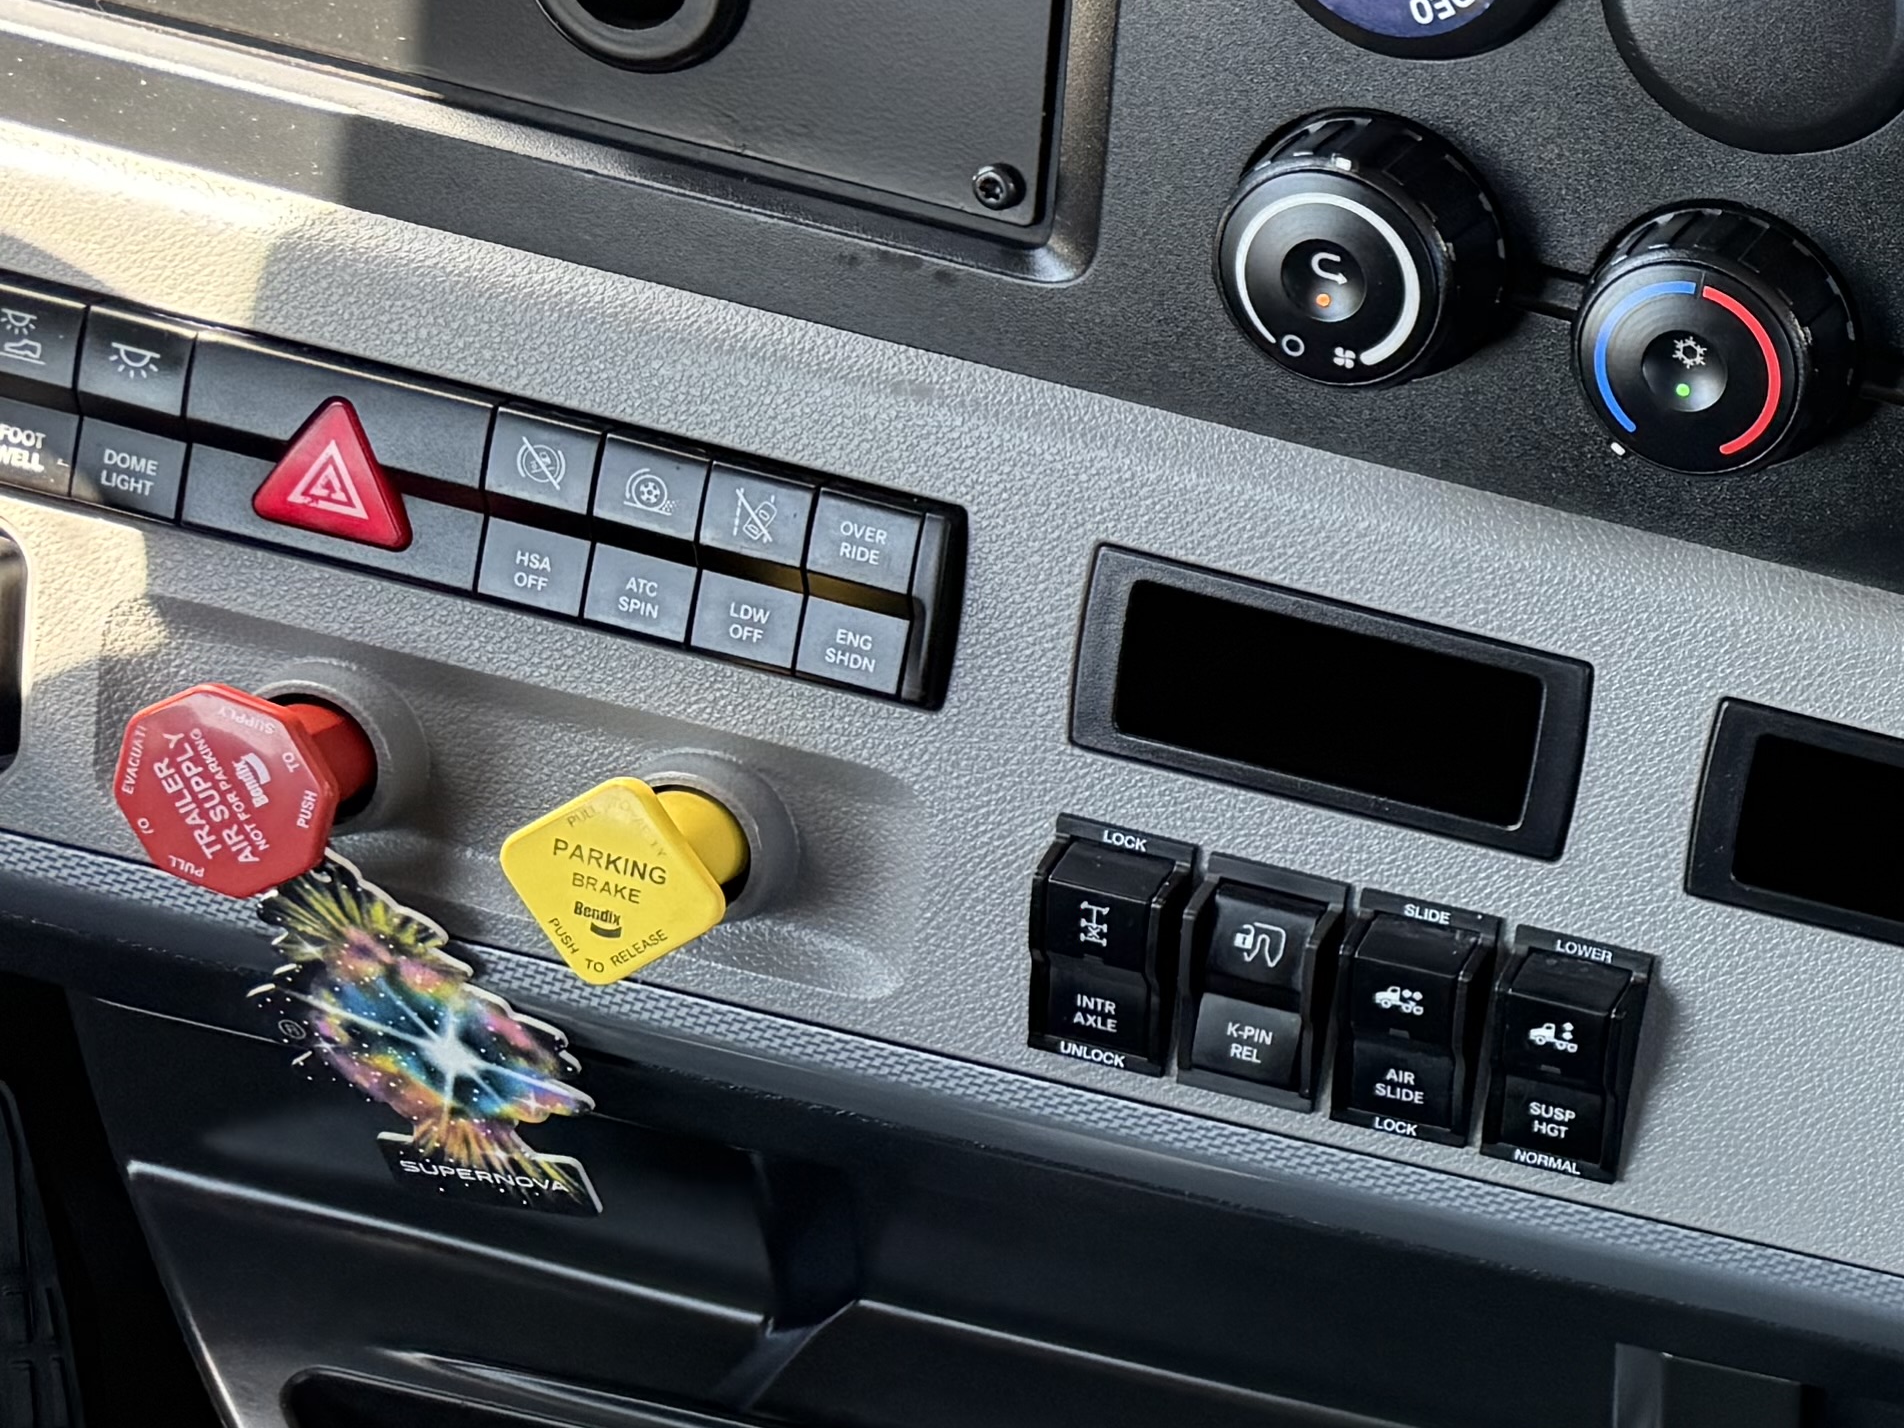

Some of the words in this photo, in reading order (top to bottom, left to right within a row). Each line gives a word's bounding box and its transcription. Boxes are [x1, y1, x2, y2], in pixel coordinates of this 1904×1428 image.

[103, 448, 159, 476] DOME
[100, 469, 155, 496] LIGHT
[839, 521, 888, 545] OVER
[515, 550, 552, 574] HSA
[838, 542, 881, 566] RIDE
[513, 573, 549, 592] OFF
[625, 576, 659, 598] ATC
[617, 596, 660, 620] SPIN
[728, 602, 771, 625] LDW
[728, 624, 765, 644] OFF
[835, 628, 873, 652] ENG
[824, 647, 876, 673] SHDN
[217, 705, 277, 735] SUPPLY
[189, 728, 230, 792] PARKING
[281, 751, 301, 773] TO
[162, 732, 230, 823] SUPPLY
[152, 757, 223, 860] TRAILER
[226, 790, 251, 822] FOR
[296, 790, 318, 829] PUSH
[222, 824, 260, 865] AIR
[243, 822, 270, 851] NOT
[1102, 829, 1147, 853] LOCK
[168, 855, 205, 878] PULL
[553, 838, 667, 886] PARKING
[571, 872, 642, 904] BRAKE
[573, 900, 621, 926] Bendix
[1403, 903, 1451, 926] SLIDE
[548, 917, 580, 955] PUSH
[585, 958, 605, 974] TO
[609, 929, 669, 967] RELEASE
[1555, 938, 1614, 965] LOWER
[1075, 993, 1118, 1016] INTR
[1072, 1009, 1118, 1034] AXLE
[1226, 1022, 1274, 1047] K-PIN
[1059, 1040, 1126, 1069] UNLOCK
[1229, 1043, 1262, 1065] REL
[1384, 1067, 1416, 1087] AIR
[1374, 1080, 1425, 1105] SLIDE
[1528, 1101, 1577, 1127] SUSP
[1373, 1116, 1418, 1138] LOCK
[1532, 1119, 1569, 1140] HGT
[1513, 1148, 1581, 1177] NORMAL
[400, 1160, 570, 1193] SUPERNOVA
